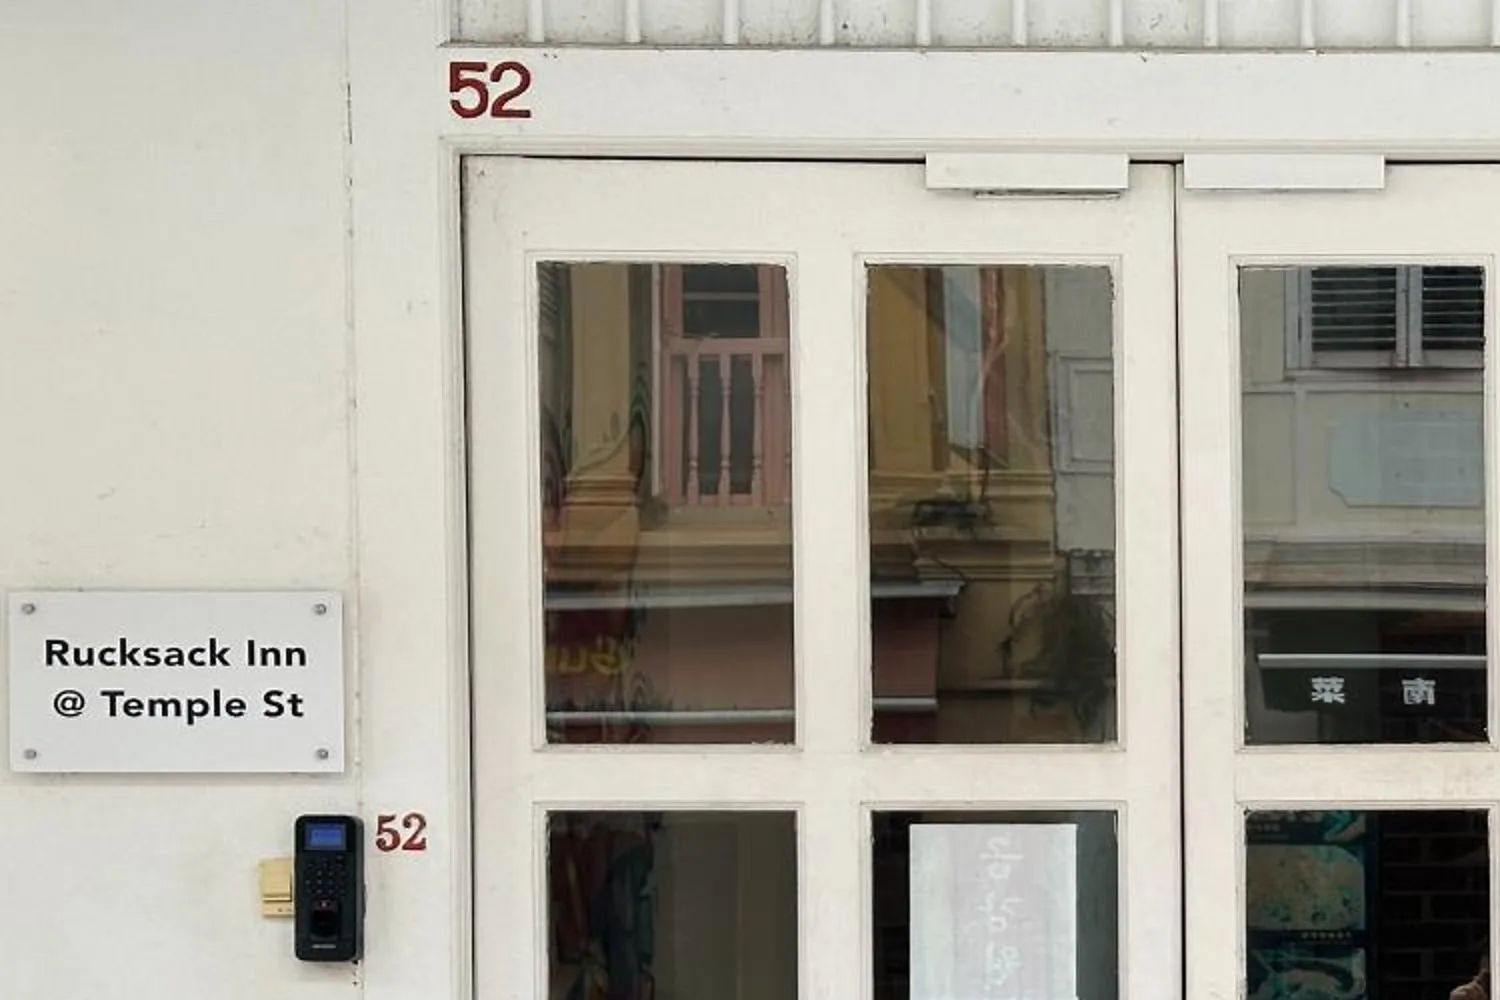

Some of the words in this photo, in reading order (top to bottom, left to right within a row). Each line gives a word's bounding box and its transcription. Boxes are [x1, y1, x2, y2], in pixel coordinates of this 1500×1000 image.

[450, 61, 532, 119] 52
[45, 638, 231, 667] Rucksack
[247, 640, 308, 667] Inn
[54, 690, 86, 719] @
[101, 690, 248, 725] Temple
[263, 691, 305, 718] St
[375, 812, 428, 852] 52
